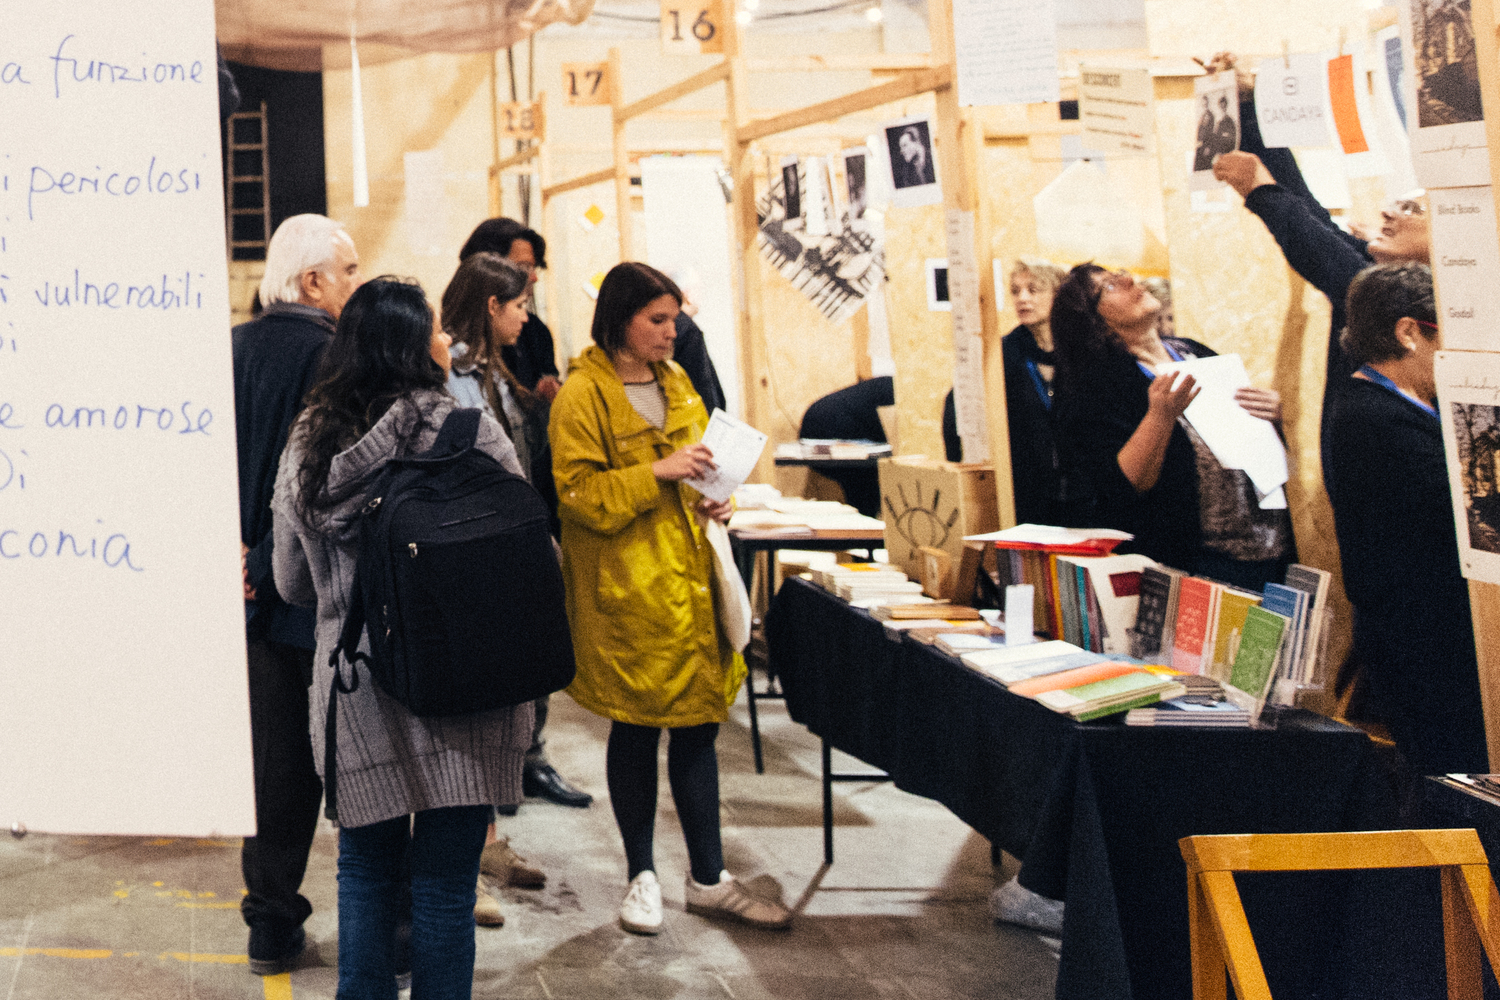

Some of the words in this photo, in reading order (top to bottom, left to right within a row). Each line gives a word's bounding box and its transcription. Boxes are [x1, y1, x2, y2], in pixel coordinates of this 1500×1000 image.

[668, 8, 717, 42] 16
[49, 35, 202, 98] funzione
[566, 70, 603, 97] 17
[504, 108, 536, 132] 18
[29, 153, 207, 221] pericolosi
[35, 269, 206, 310] vulnerabili
[45, 401, 214, 435] amorose
